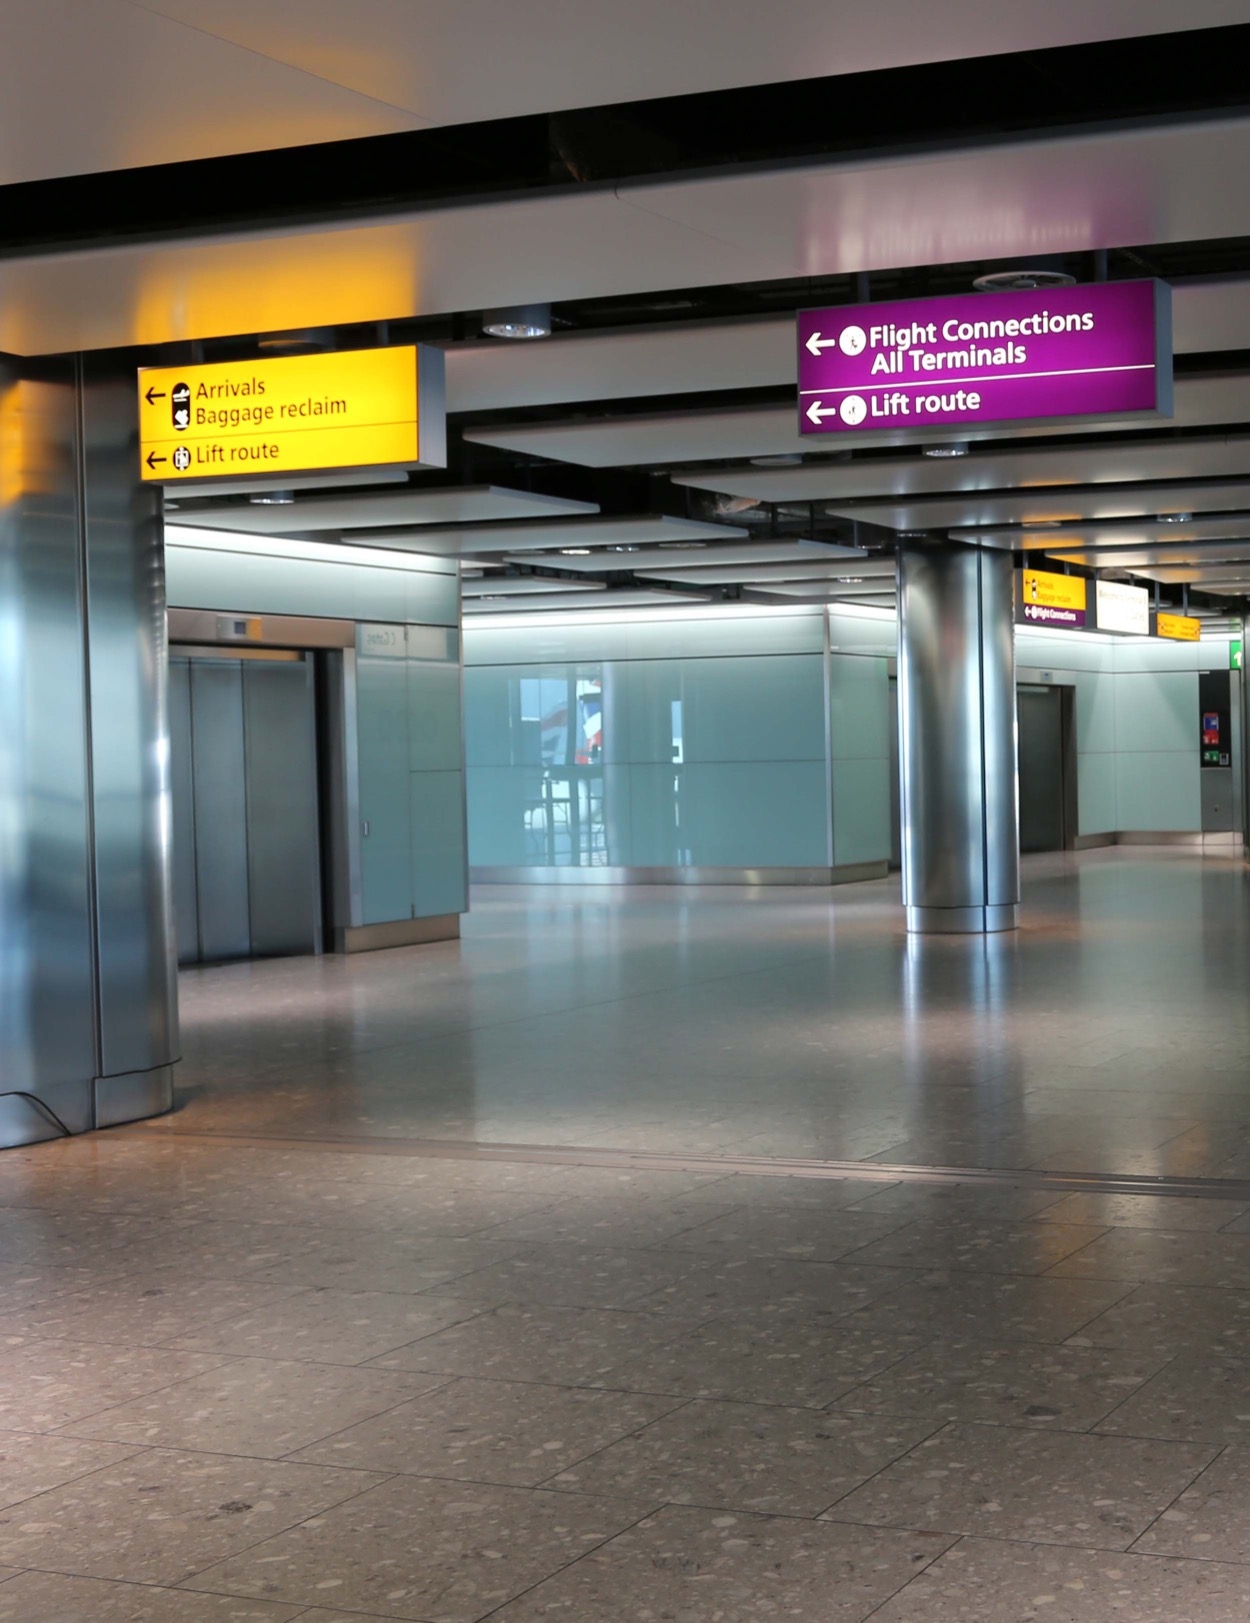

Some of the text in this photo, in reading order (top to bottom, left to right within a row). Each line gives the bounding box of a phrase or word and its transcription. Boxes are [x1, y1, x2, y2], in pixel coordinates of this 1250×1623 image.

[869, 310, 1094, 350] Flight Connections
[870, 341, 1027, 375] All Terminals
[196, 377, 266, 400] Arrivals
[871, 388, 981, 417] Lift route
[196, 397, 347, 427] Baggage reclaim
[196, 441, 280, 464] Lift route
